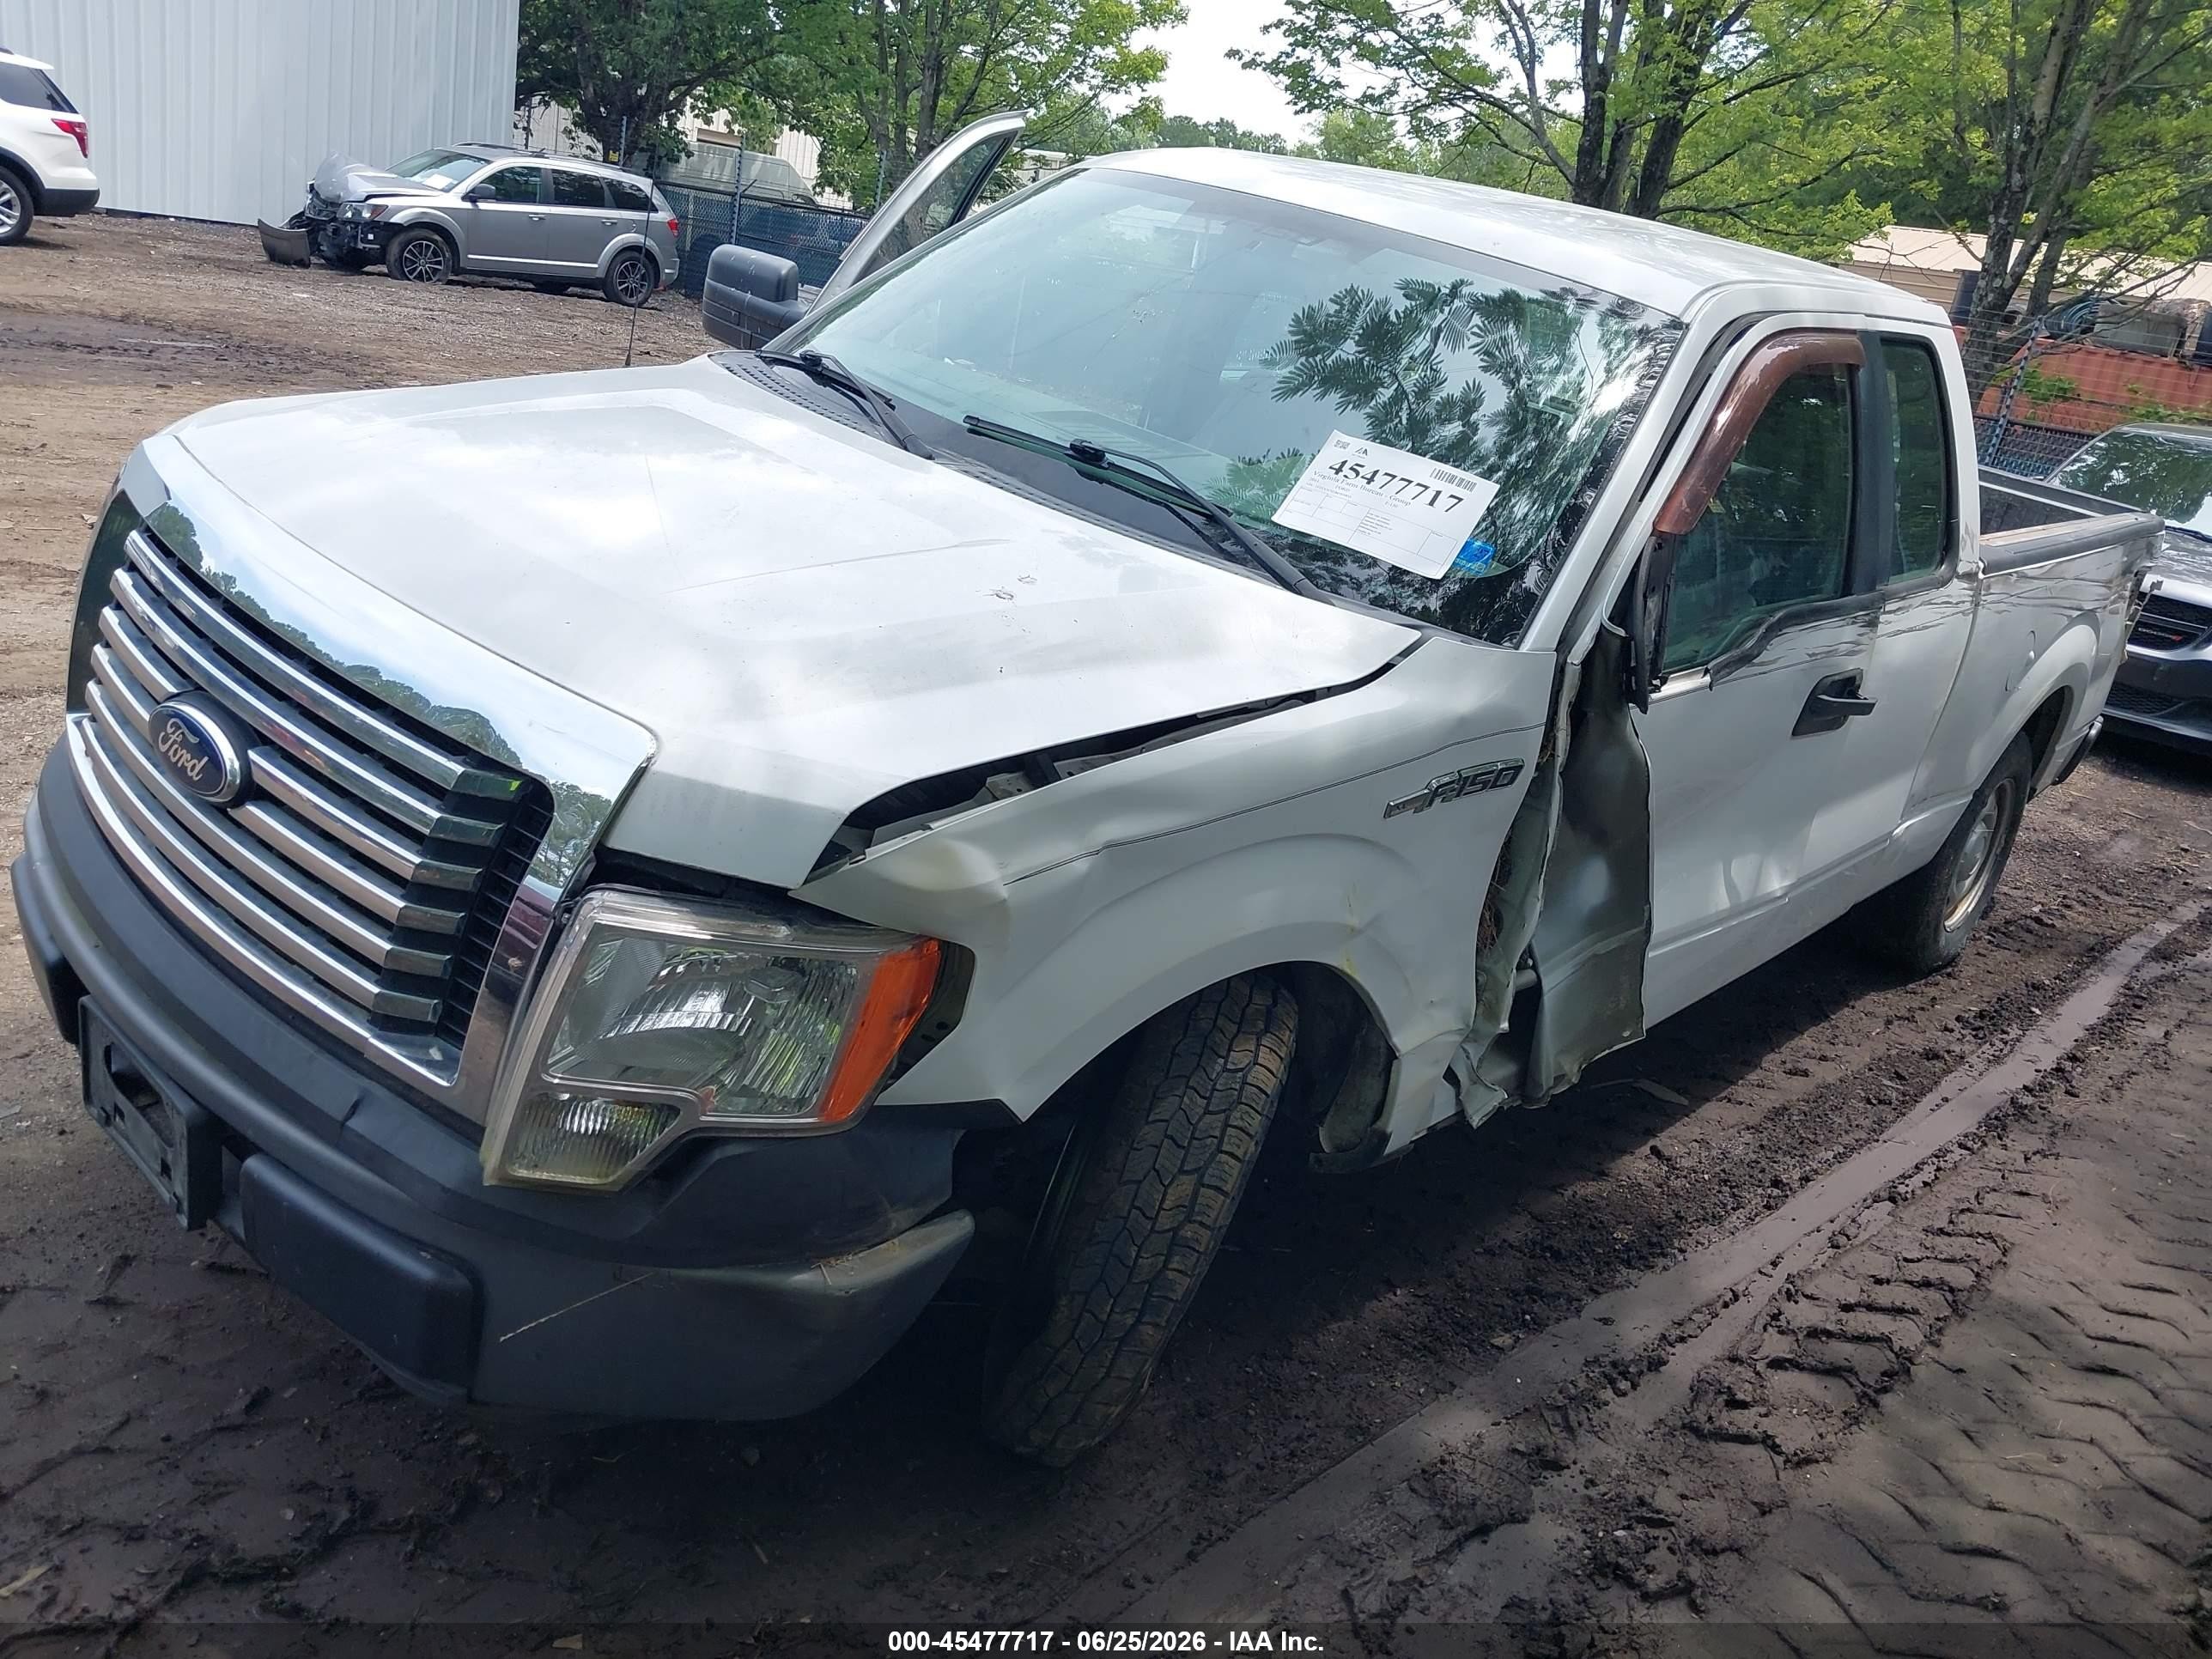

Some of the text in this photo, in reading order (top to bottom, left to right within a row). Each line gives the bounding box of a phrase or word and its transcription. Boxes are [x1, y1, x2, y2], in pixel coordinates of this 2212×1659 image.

[1313, 470, 1340, 483] Virginia
[1340, 479, 1358, 490] Farm
[1359, 484, 1384, 498] Bureau
[1389, 495, 1411, 507] Group
[1328, 459, 1464, 513] 45477717
[158, 717, 210, 781] Ford
